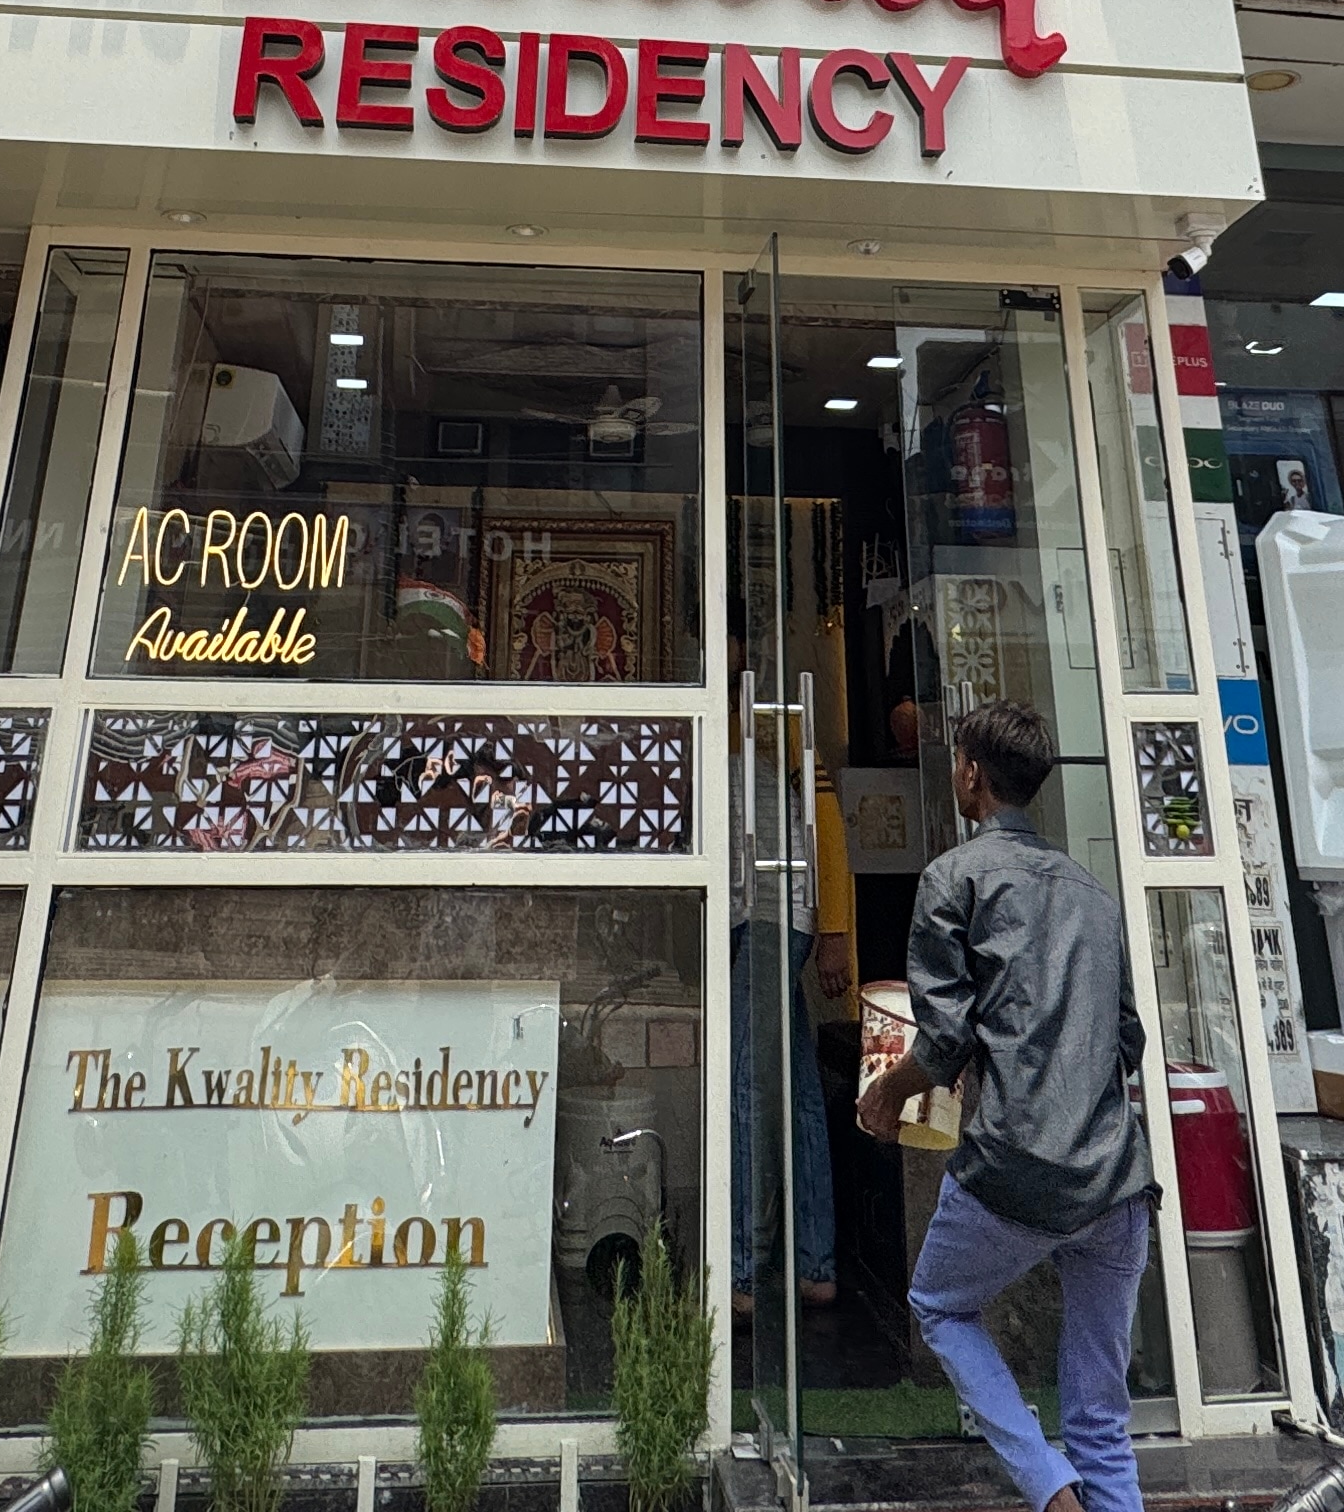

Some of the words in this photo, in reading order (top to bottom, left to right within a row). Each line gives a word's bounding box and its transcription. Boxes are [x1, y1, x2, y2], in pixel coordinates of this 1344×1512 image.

[232, 16, 972, 159] RESIDENCY
[117, 507, 191, 587] AC
[200, 508, 350, 590] ROOM
[126, 607, 316, 664] Available
[66, 1048, 147, 1112] The
[165, 1045, 324, 1125] Kwality
[340, 1046, 549, 1128] Residency
[79, 1191, 489, 1297] Reception
